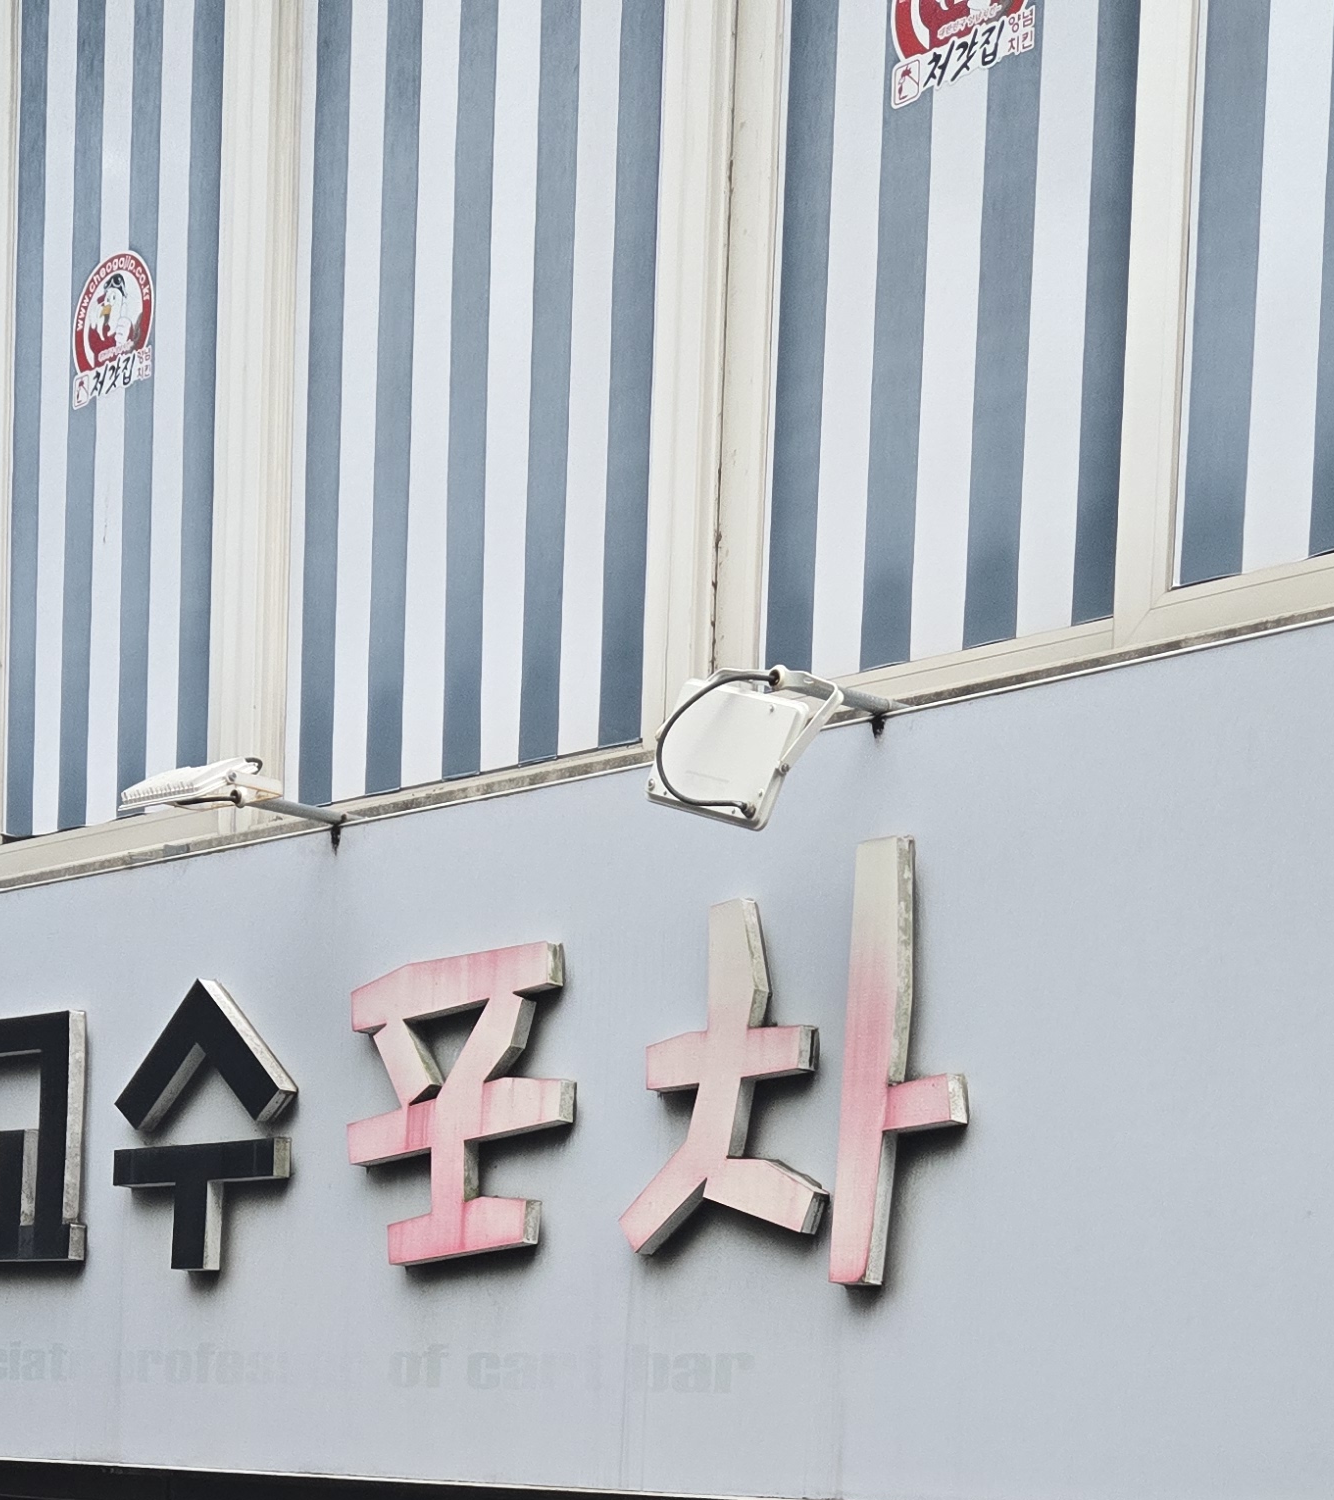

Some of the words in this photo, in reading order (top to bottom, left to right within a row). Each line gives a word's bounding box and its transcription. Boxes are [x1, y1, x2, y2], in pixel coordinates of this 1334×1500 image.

[1008, 8, 1033, 33] 양념
[1008, 31, 1033, 53] 치킨
[923, 20, 1005, 87] 처갓집
[347, 835, 970, 1289] 포차
